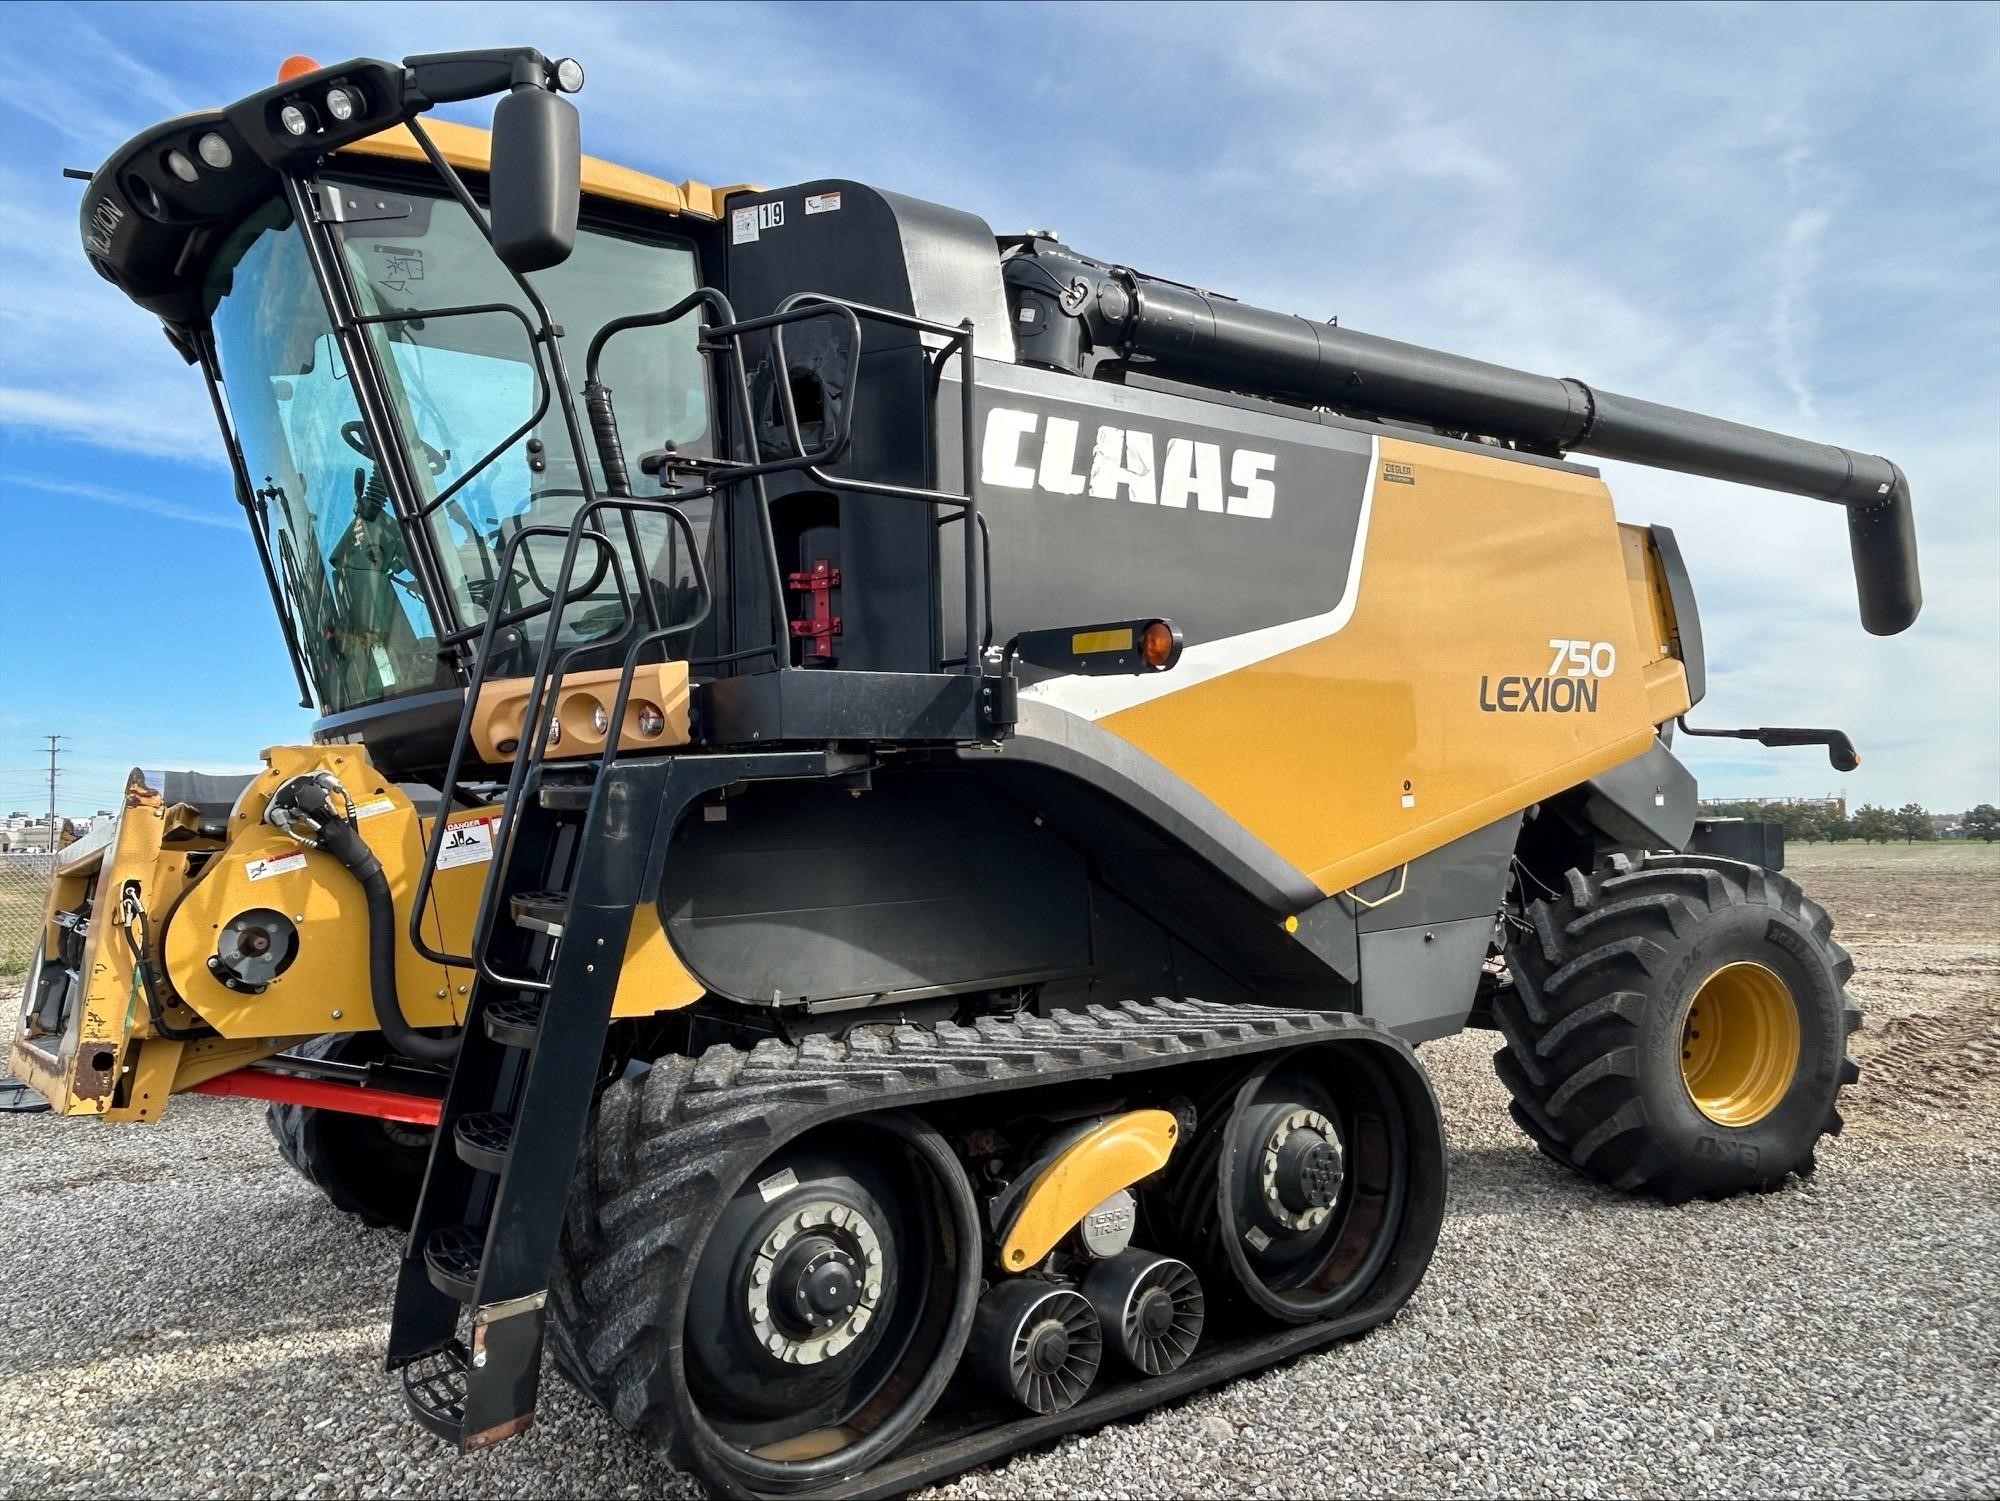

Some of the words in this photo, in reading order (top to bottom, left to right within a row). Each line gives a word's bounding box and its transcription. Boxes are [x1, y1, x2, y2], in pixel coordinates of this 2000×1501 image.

[763, 202, 783, 227] 19
[981, 407, 1276, 519] CLAAS
[1548, 639, 1616, 678] 750
[1479, 675, 1598, 713] LEXION
[447, 819, 480, 831] DANGER
[1089, 1206, 1130, 1226] TERRA
[1094, 1219, 1128, 1237] TRAC
